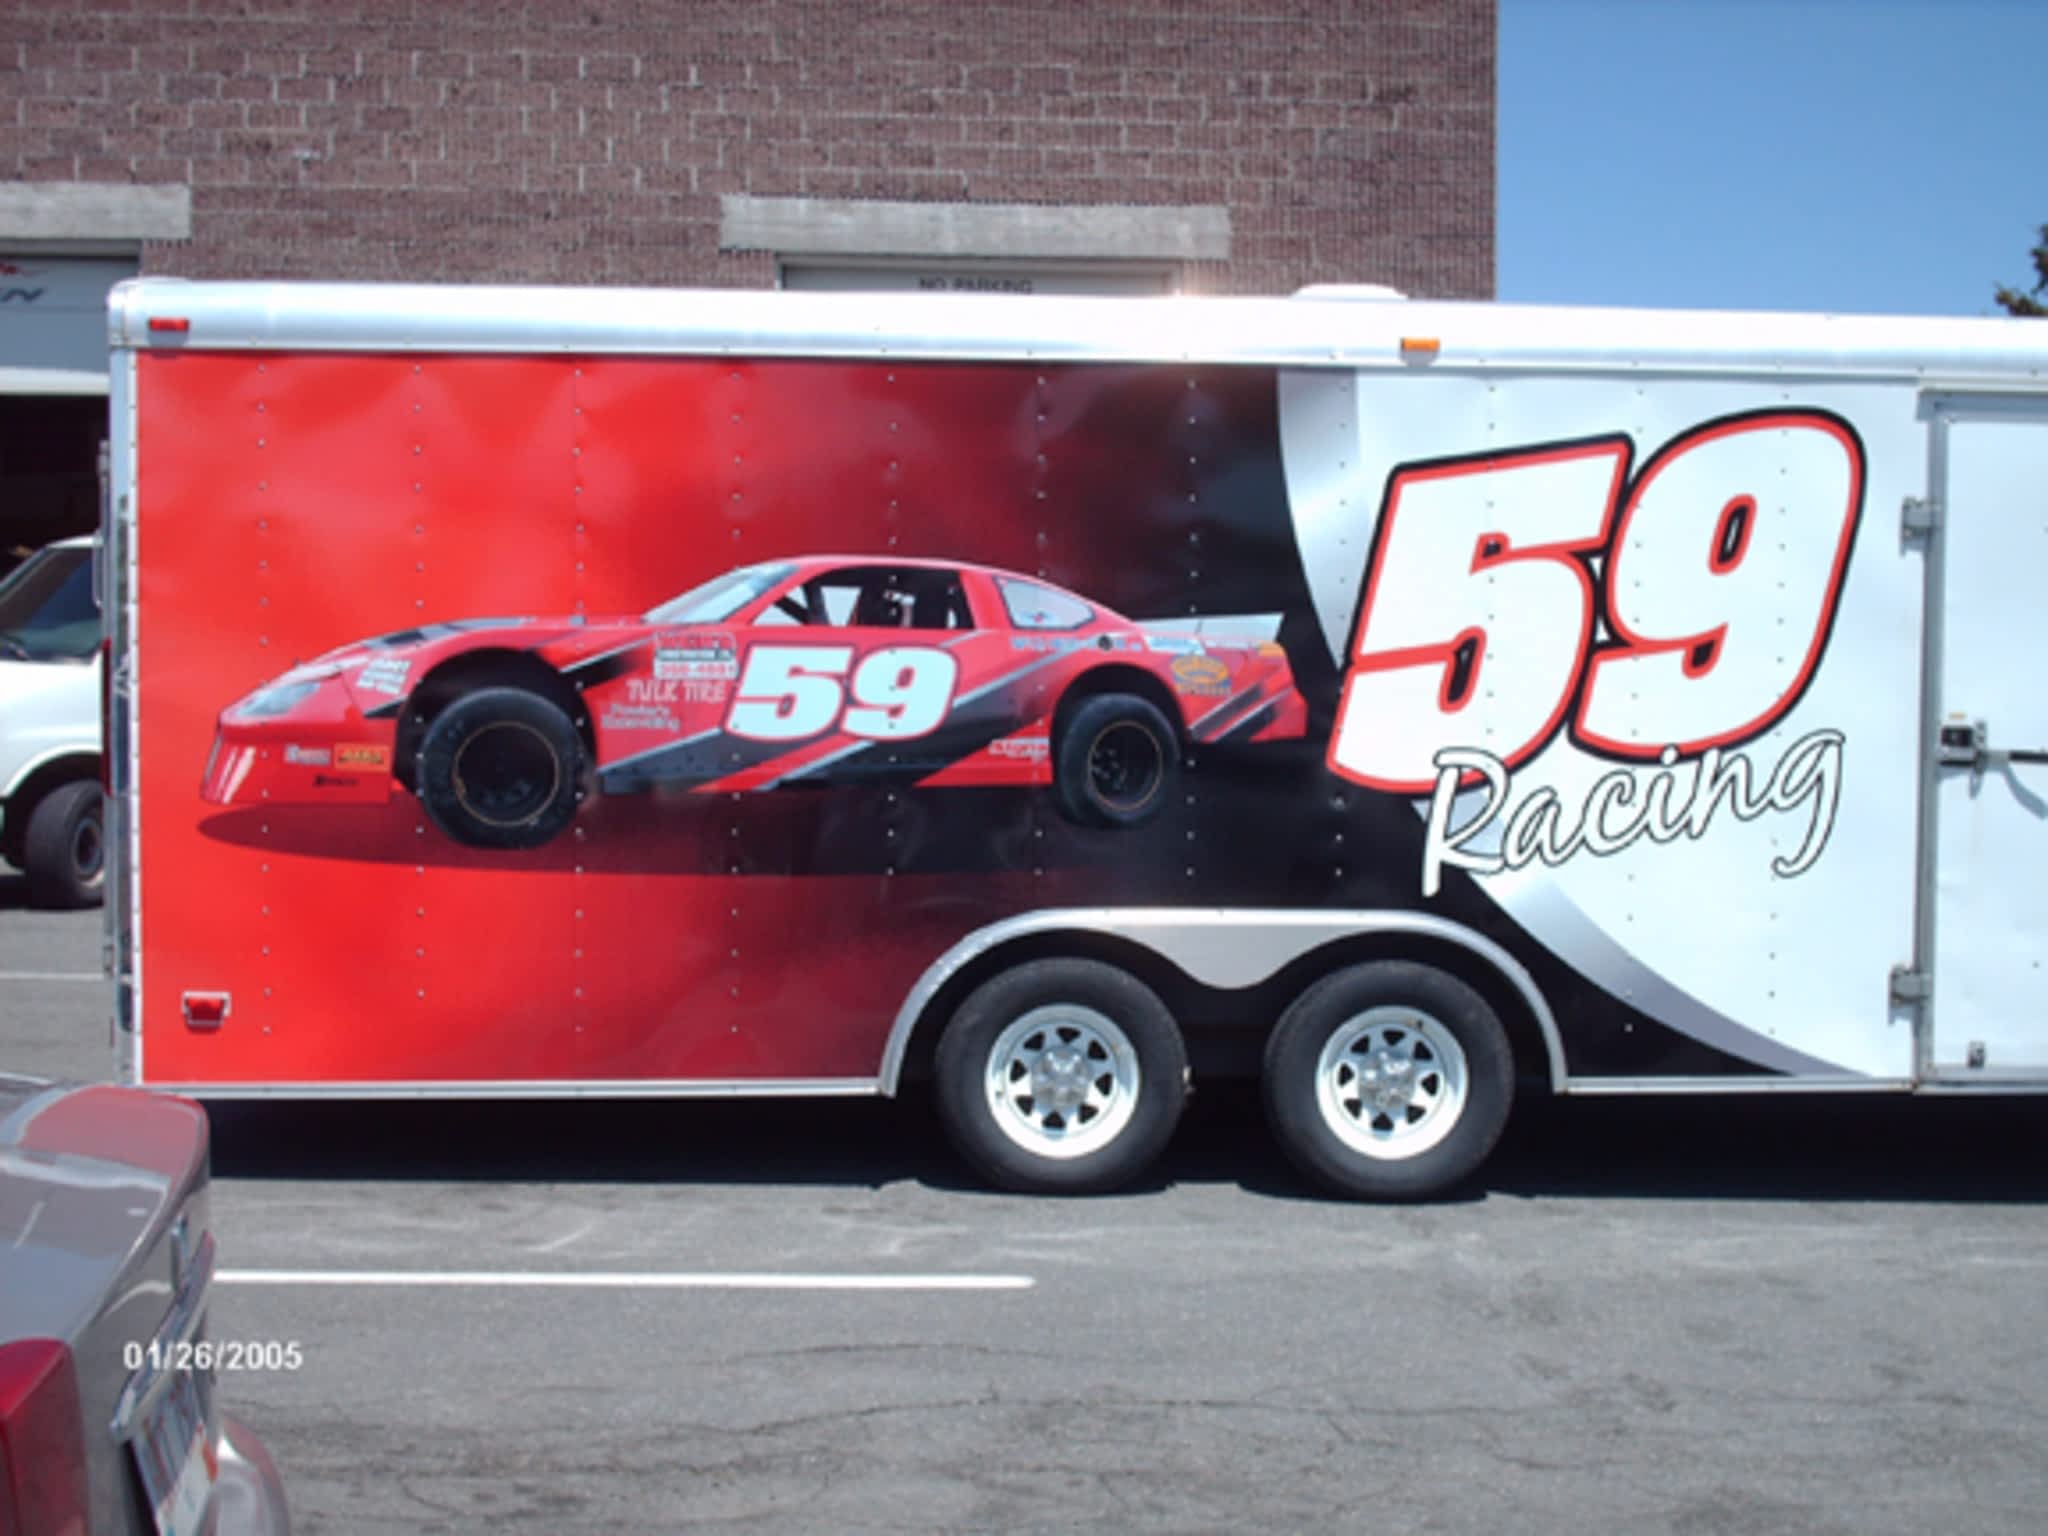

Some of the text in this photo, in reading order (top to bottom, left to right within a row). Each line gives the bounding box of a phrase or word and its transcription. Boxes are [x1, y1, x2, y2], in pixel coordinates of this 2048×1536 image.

[1326, 406, 1867, 795] 59
[725, 645, 957, 741] 59
[1420, 728, 1846, 897] Racing
